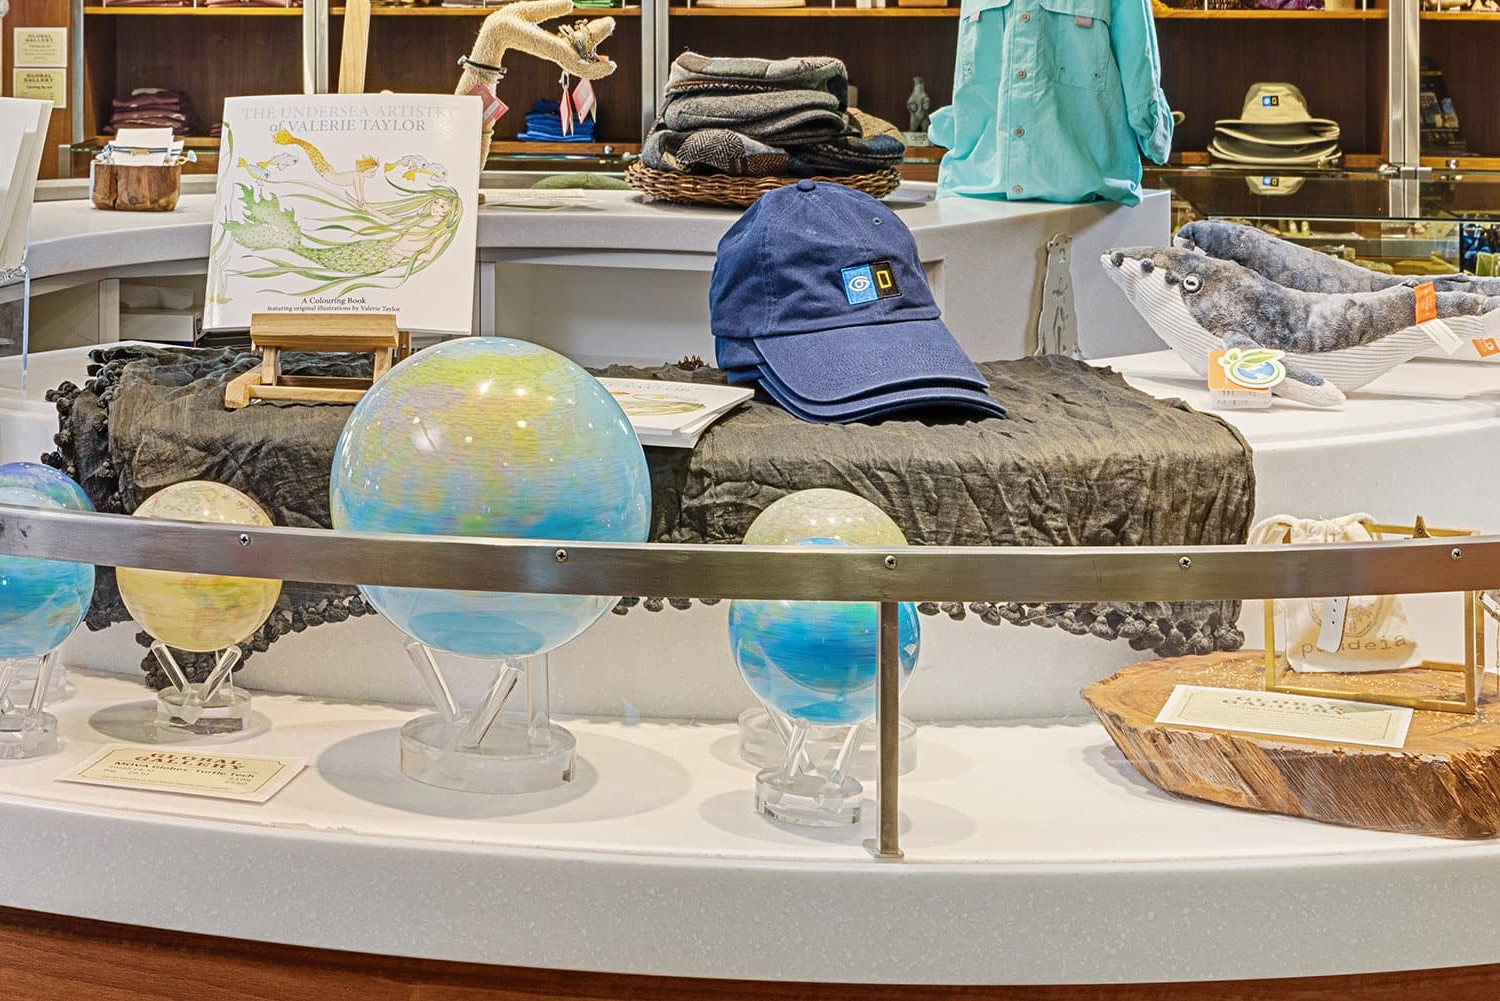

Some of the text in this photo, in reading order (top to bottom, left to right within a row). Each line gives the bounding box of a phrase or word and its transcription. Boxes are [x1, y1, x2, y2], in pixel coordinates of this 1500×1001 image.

[242, 107, 279, 120] THE
[280, 105, 369, 119] UNDERSEA
[269, 118, 428, 132] of VALERIE TAYLOR
[309, 297, 346, 306] Colouring
[293, 305, 316, 313] original
[1301, 634, 1407, 659] pdeia
[134, 756, 246, 770] GALLERY
[150, 752, 243, 766] GLOBAL
